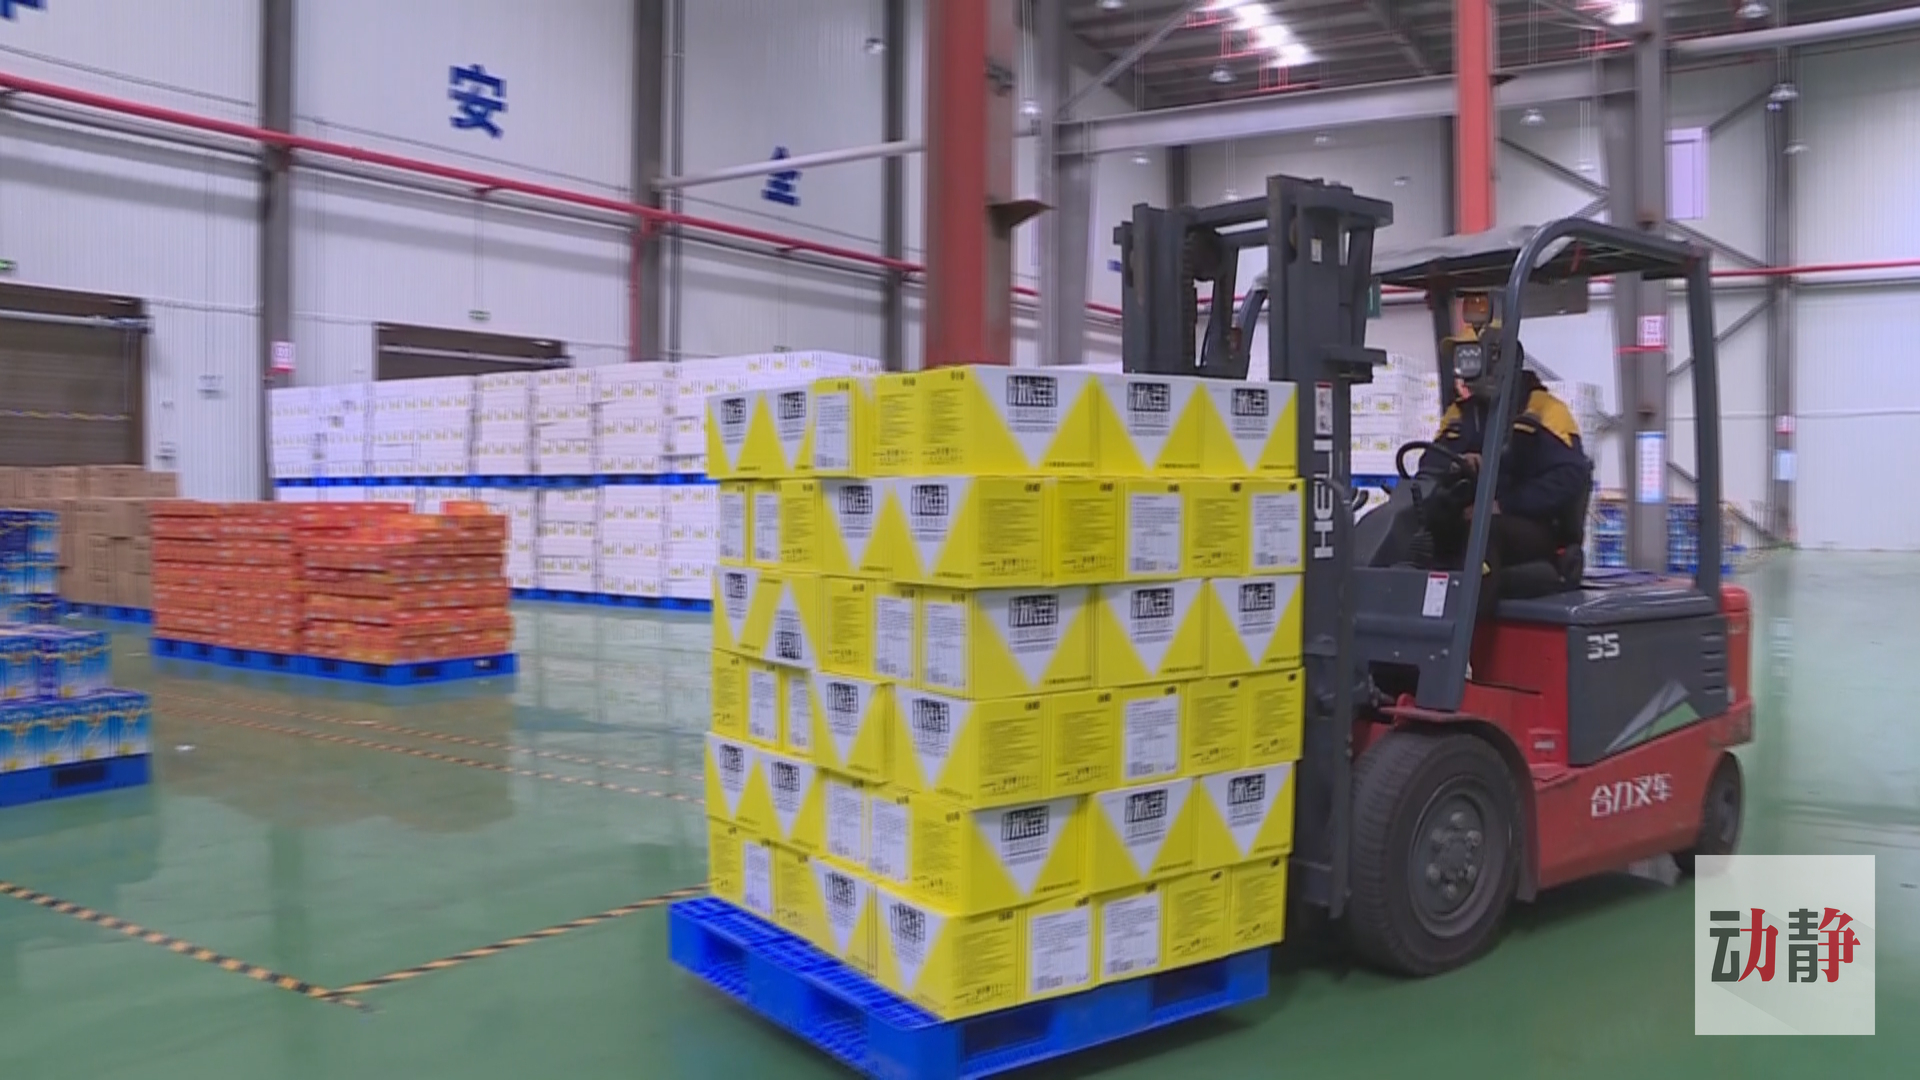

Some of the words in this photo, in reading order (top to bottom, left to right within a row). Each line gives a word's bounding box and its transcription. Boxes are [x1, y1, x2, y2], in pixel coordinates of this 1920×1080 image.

[448, 64, 508, 138] 安
[761, 146, 803, 206] 全
[1313, 439, 1334, 559] HELI
[1586, 632, 1620, 660] 35
[1590, 773, 1673, 818] 合力叉车
